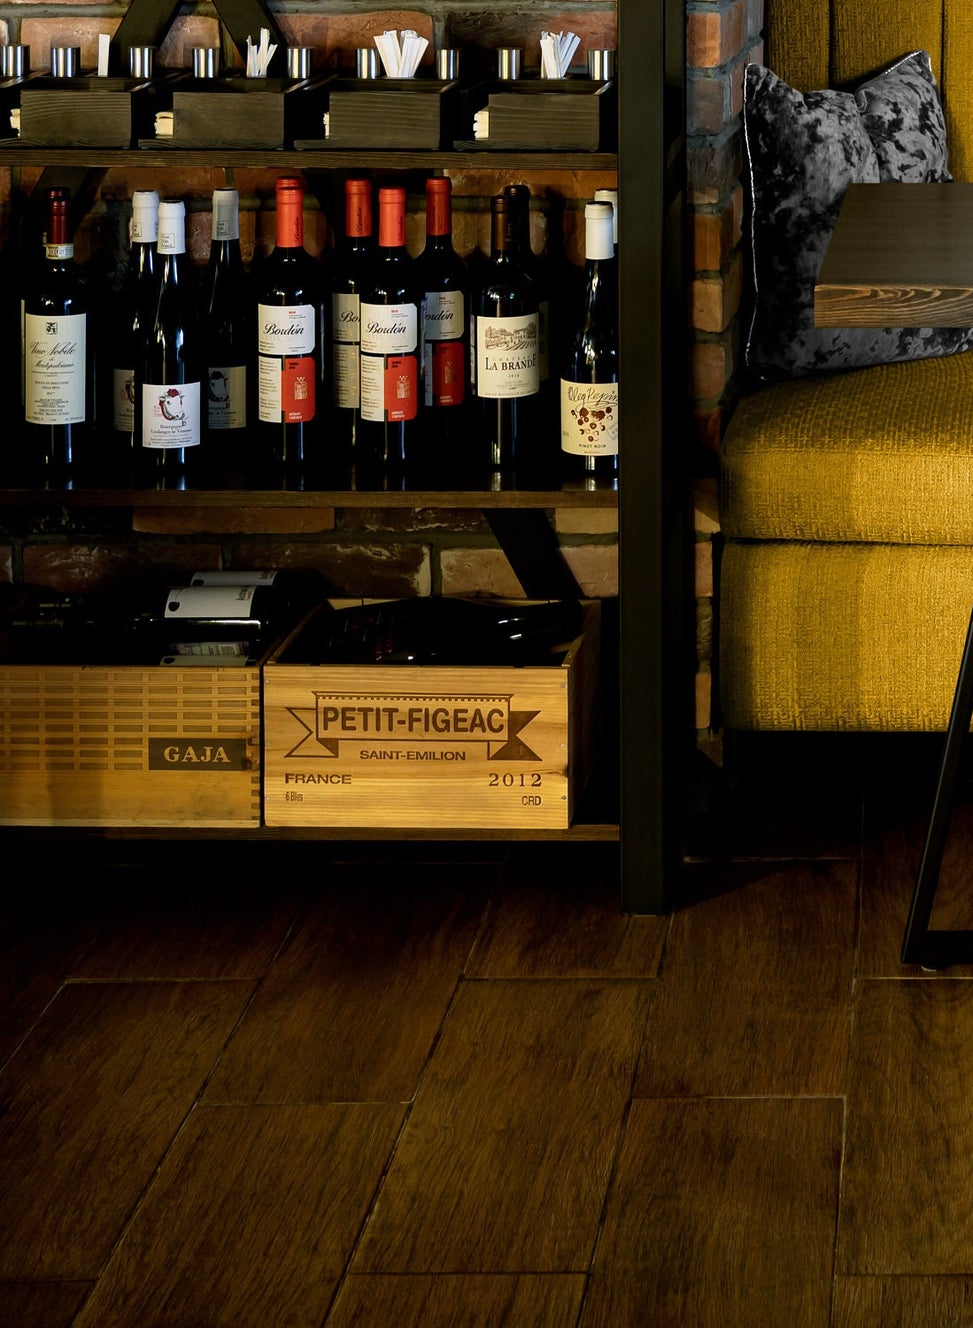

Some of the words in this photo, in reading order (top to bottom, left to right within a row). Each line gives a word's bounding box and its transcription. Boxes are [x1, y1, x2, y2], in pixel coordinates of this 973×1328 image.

[425, 310, 454, 321] ordón
[501, 353, 537, 370] BRANDE
[322, 706, 505, 733] PETIT-FIGEAC
[163, 746, 231, 763] GAJA
[359, 750, 466, 761] SAINT-EMILION
[284, 773, 352, 785] FRANCE
[488, 773, 542, 787] 2012
[521, 795, 542, 806] CRD
